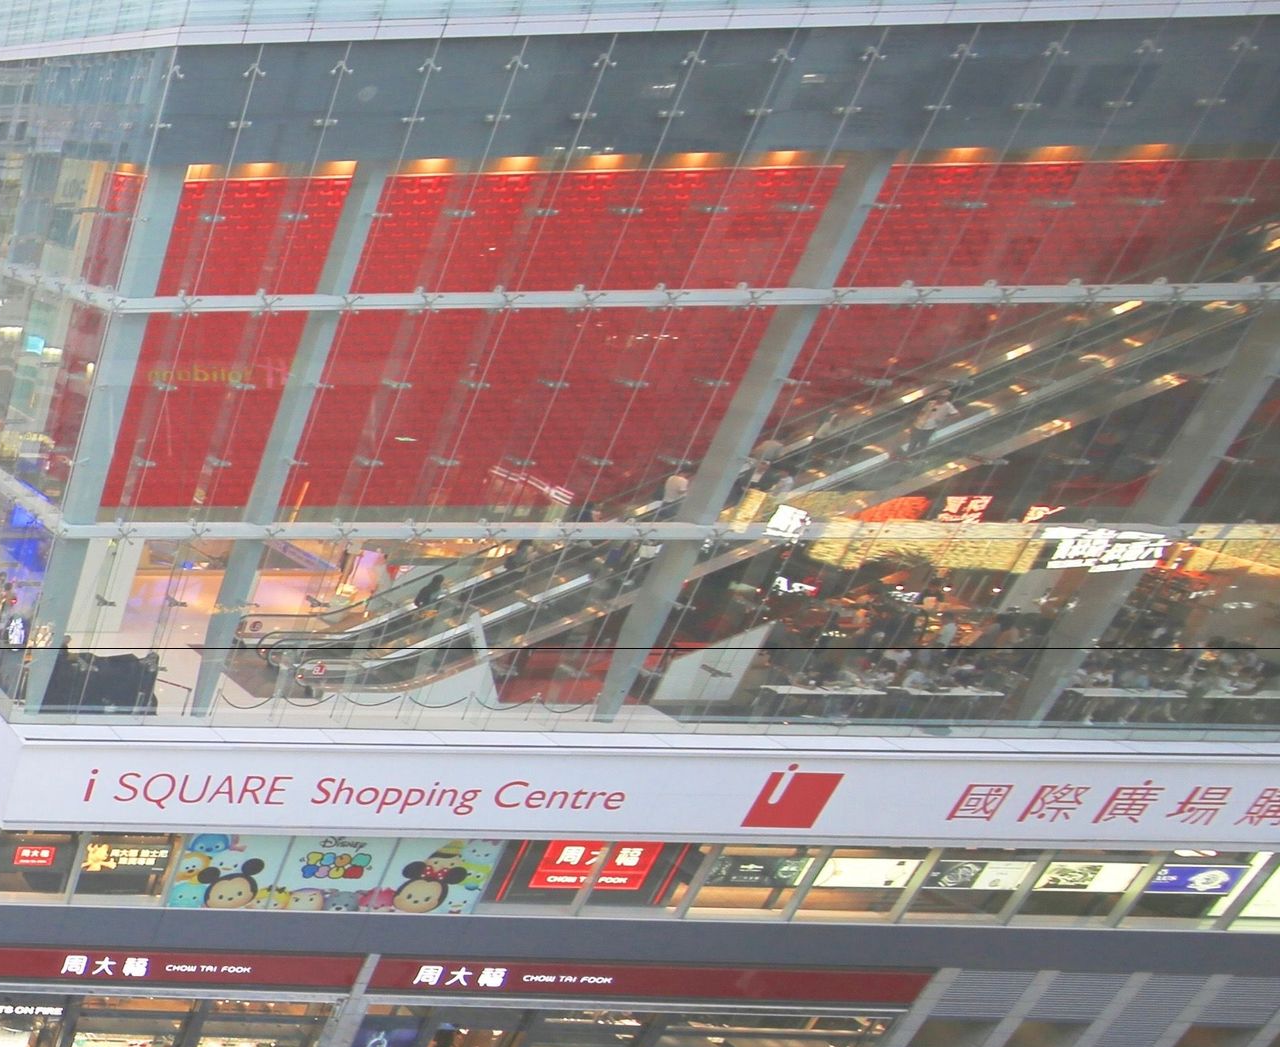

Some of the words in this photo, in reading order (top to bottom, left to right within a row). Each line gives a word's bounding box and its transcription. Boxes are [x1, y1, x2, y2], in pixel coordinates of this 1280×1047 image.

[83, 769, 100, 803] i
[113, 772, 295, 810] SQUARE
[310, 776, 483, 817] Shopping
[494, 780, 627, 812] Centre
[320, 835, 368, 853] Disney
[60, 953, 150, 977] 周大福
[165, 964, 196, 973] CHOW
[199, 965, 218, 973] TAI
[220, 965, 252, 974] FOOK
[413, 964, 507, 988] 周大福
[522, 974, 557, 984] CHOW
[558, 975, 578, 984] TAI
[580, 975, 613, 985] FOOK
